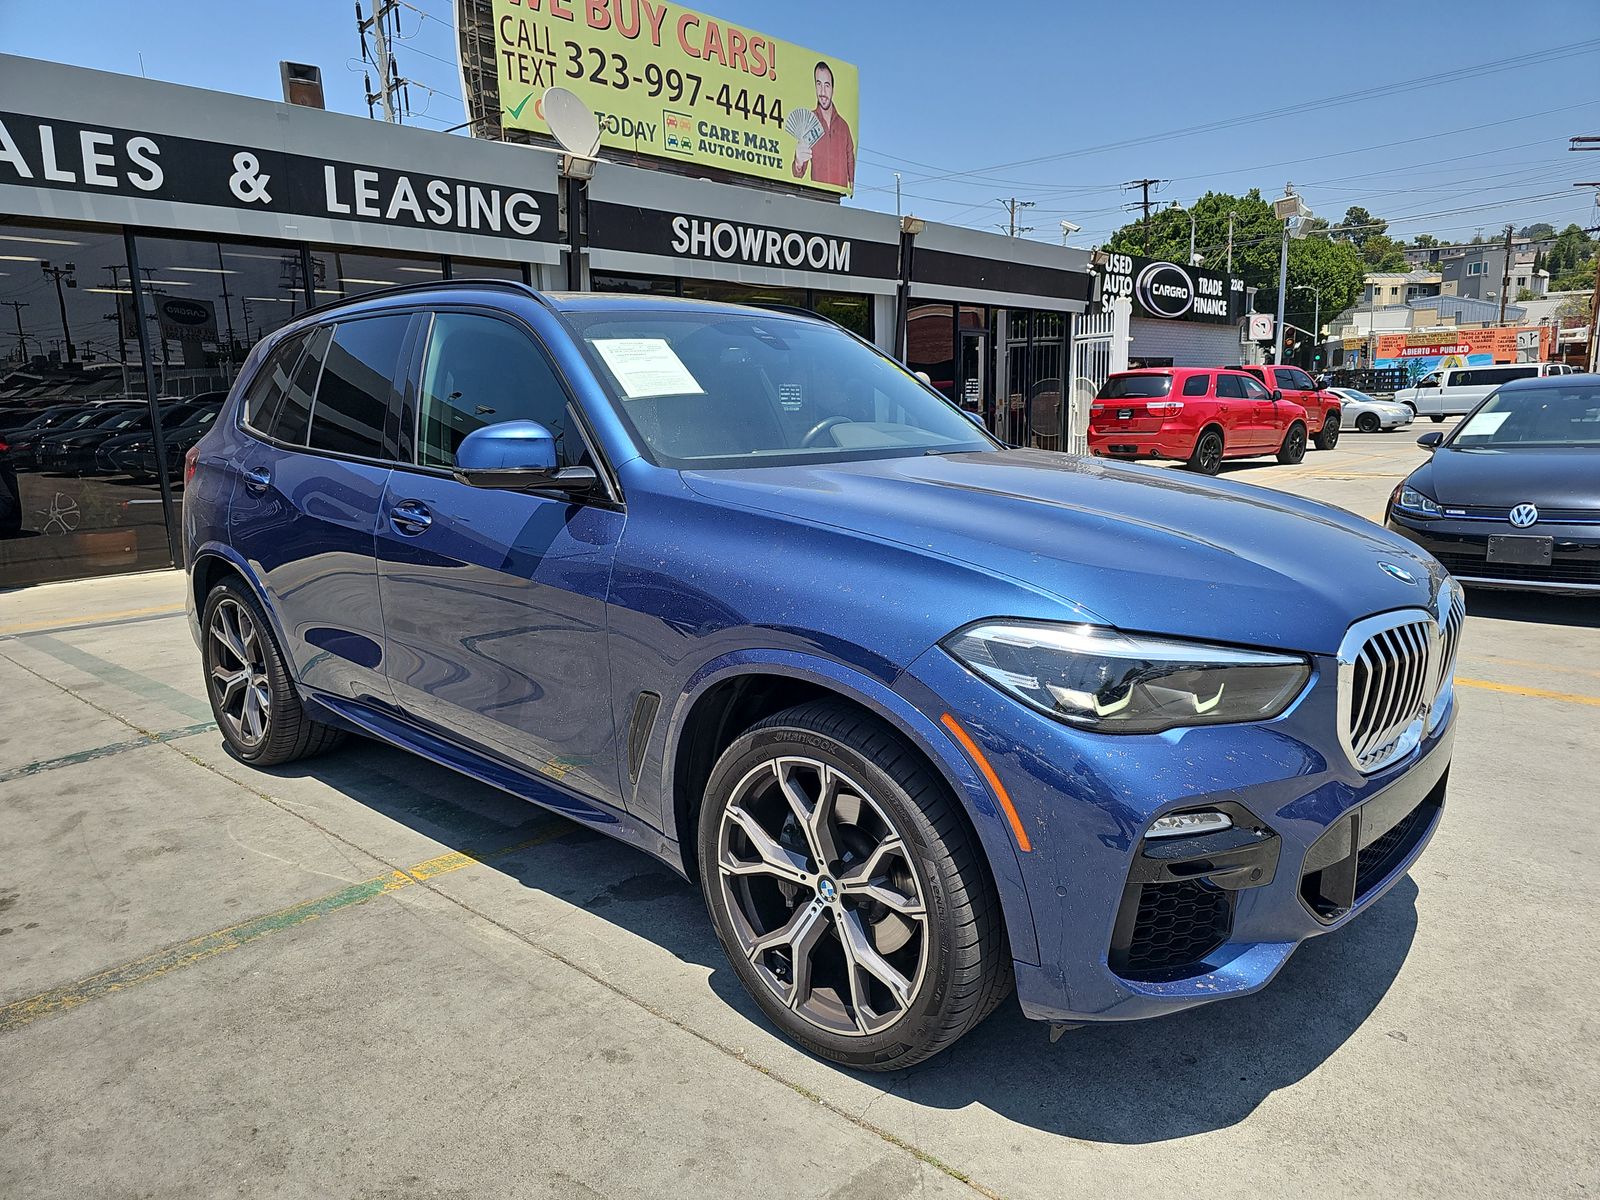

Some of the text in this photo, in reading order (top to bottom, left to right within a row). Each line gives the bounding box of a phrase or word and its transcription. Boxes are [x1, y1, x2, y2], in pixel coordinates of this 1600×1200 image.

[500, 15, 557, 57] CALL
[585, 0, 777, 81] BUY CARS!
[501, 49, 557, 88] TEXT
[564, 40, 784, 129] 323-997-4444
[594, 110, 657, 142] TODAY
[698, 120, 780, 154] CARE MAX
[699, 138, 783, 170] AUTOMOTIVE
[229, 151, 273, 205] &
[324, 165, 541, 235] LEASING
[670, 216, 850, 272] SHOWROOM
[1105, 253, 1133, 275] USED
[1103, 273, 1133, 295] AUTO
[1152, 283, 1188, 299] CARGRO
[1198, 277, 1223, 297] TRADE
[1193, 297, 1227, 317] FINANCE
[1401, 347, 1431, 356] ABIERTO
[1439, 345, 1469, 354] PUBLICO
